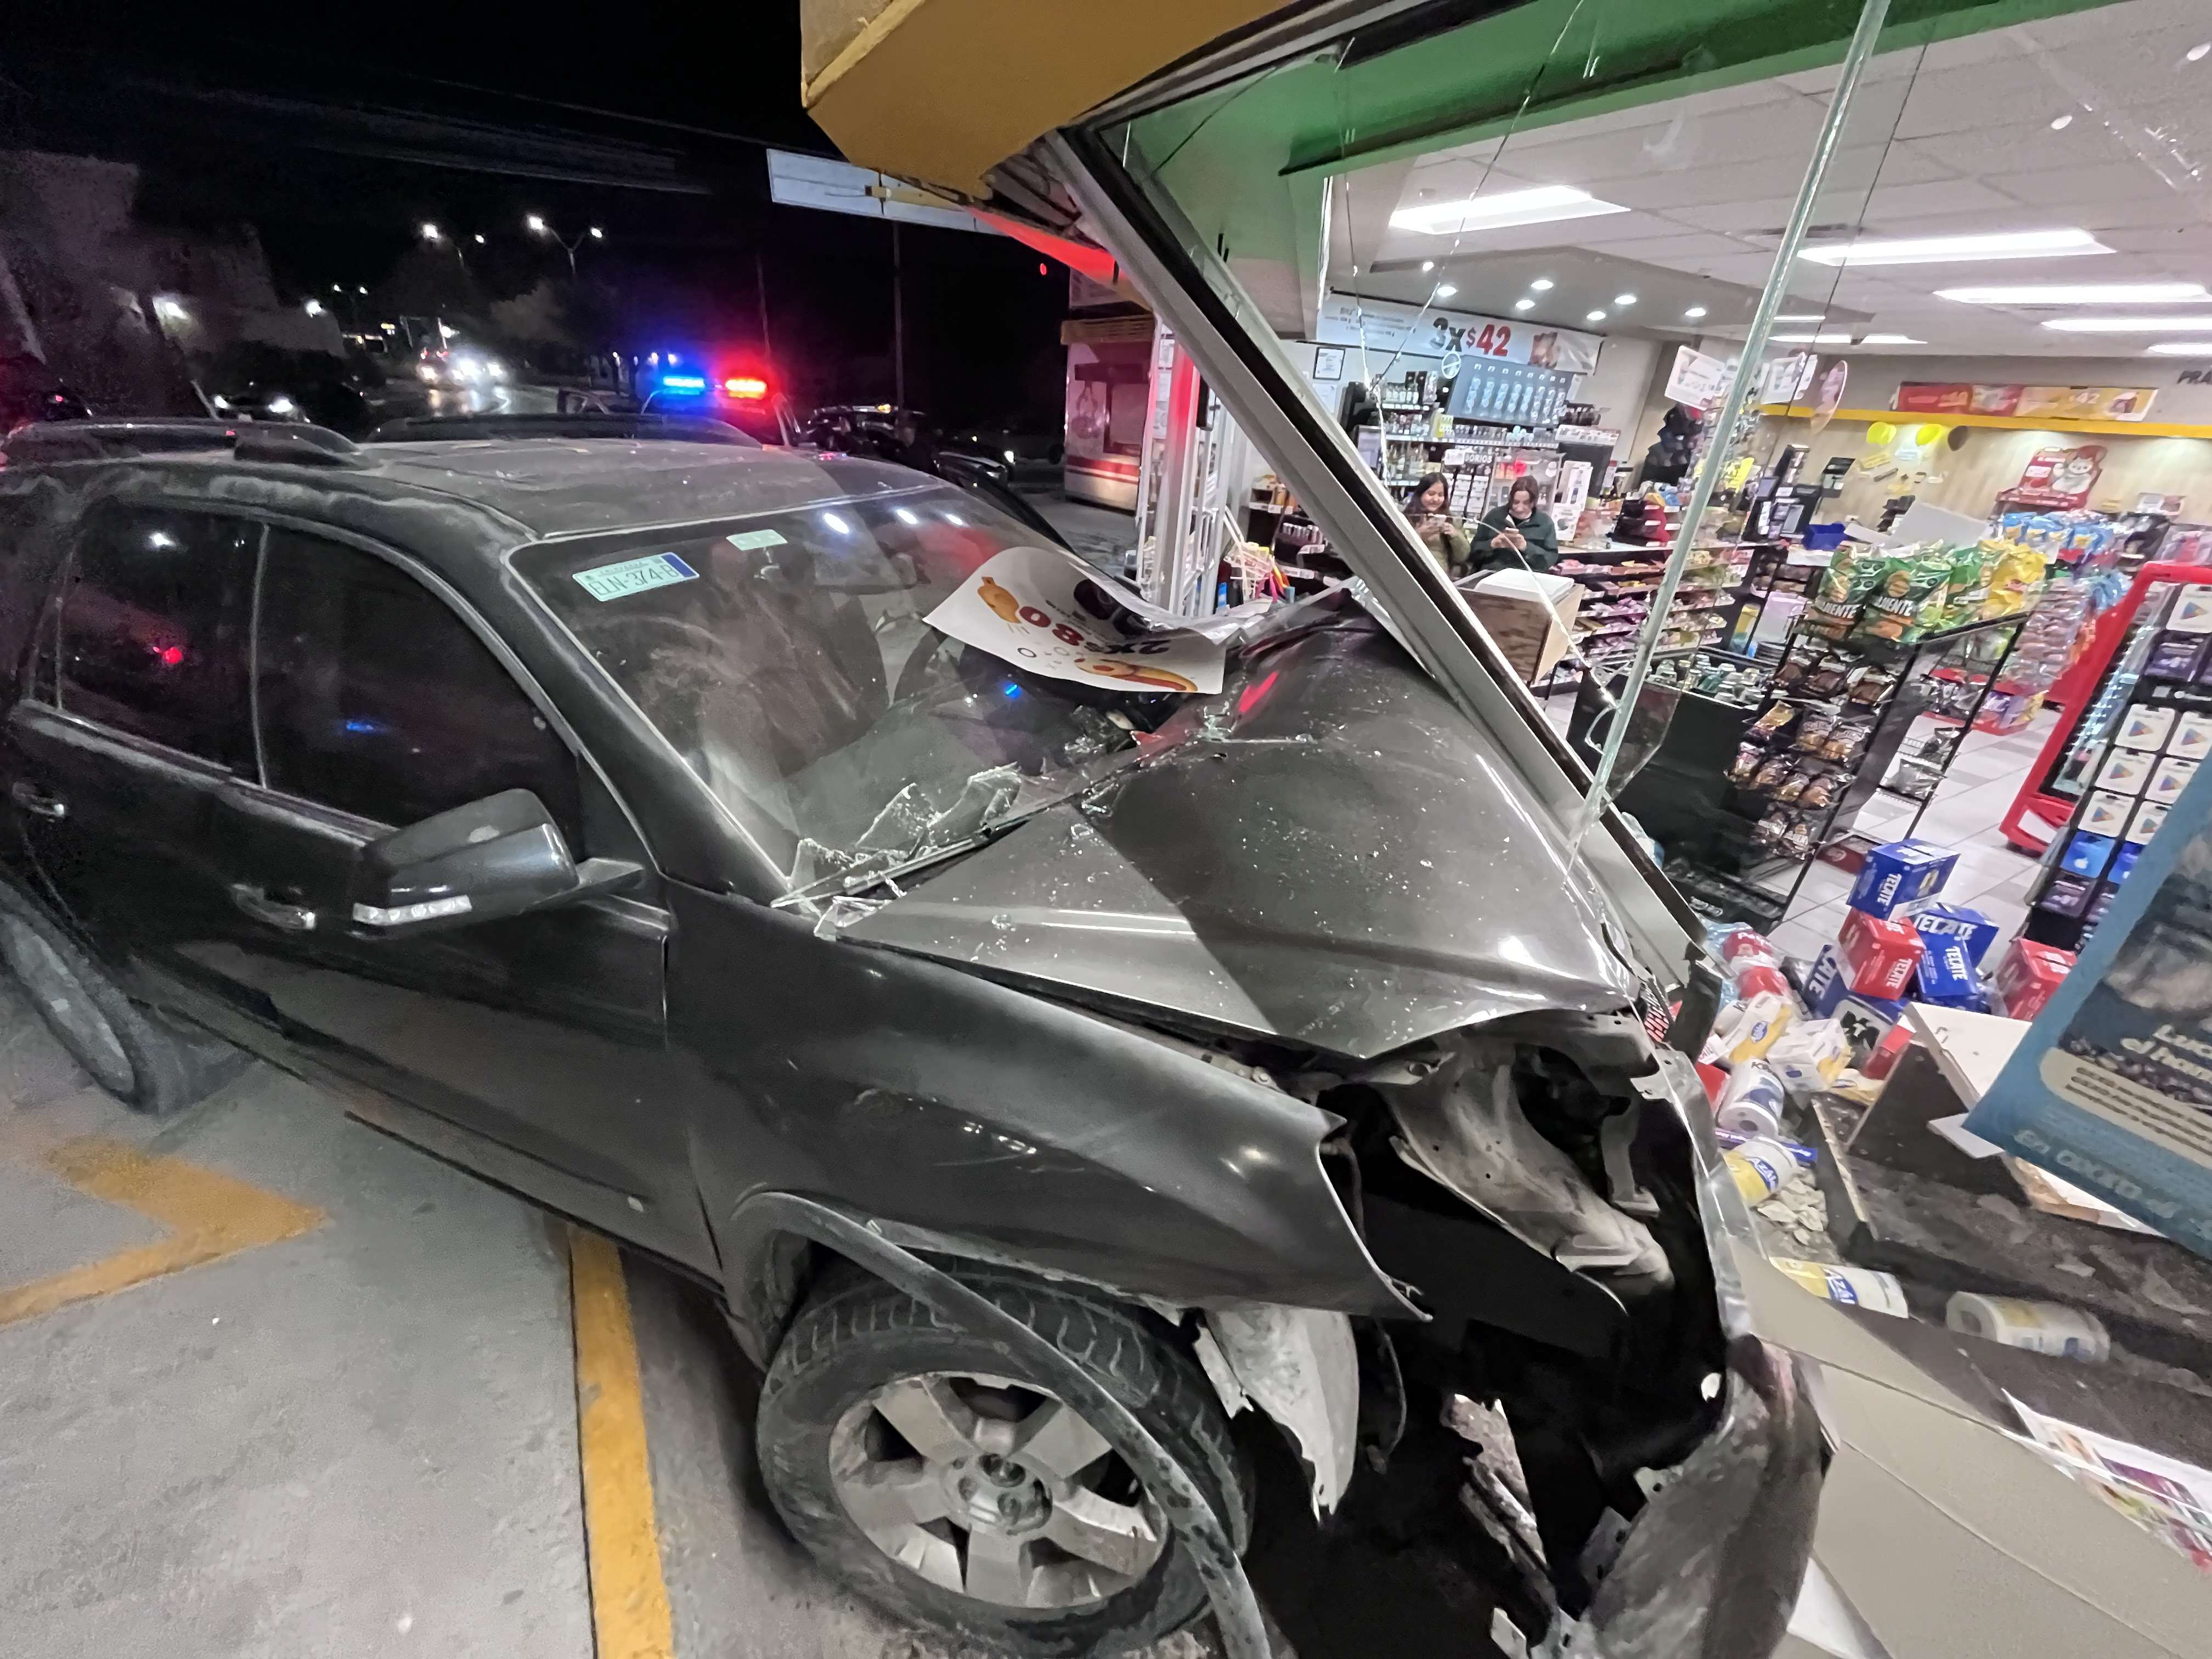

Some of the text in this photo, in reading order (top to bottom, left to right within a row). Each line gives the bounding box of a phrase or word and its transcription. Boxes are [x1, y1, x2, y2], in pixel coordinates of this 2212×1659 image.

[588, 564, 679, 596] ELN-374-B
[1877, 873, 1902, 906] TECATE
[1913, 913, 1978, 940] TECATE
[1886, 958, 1913, 989] TECATE
[1945, 946, 1968, 981] TECATE
